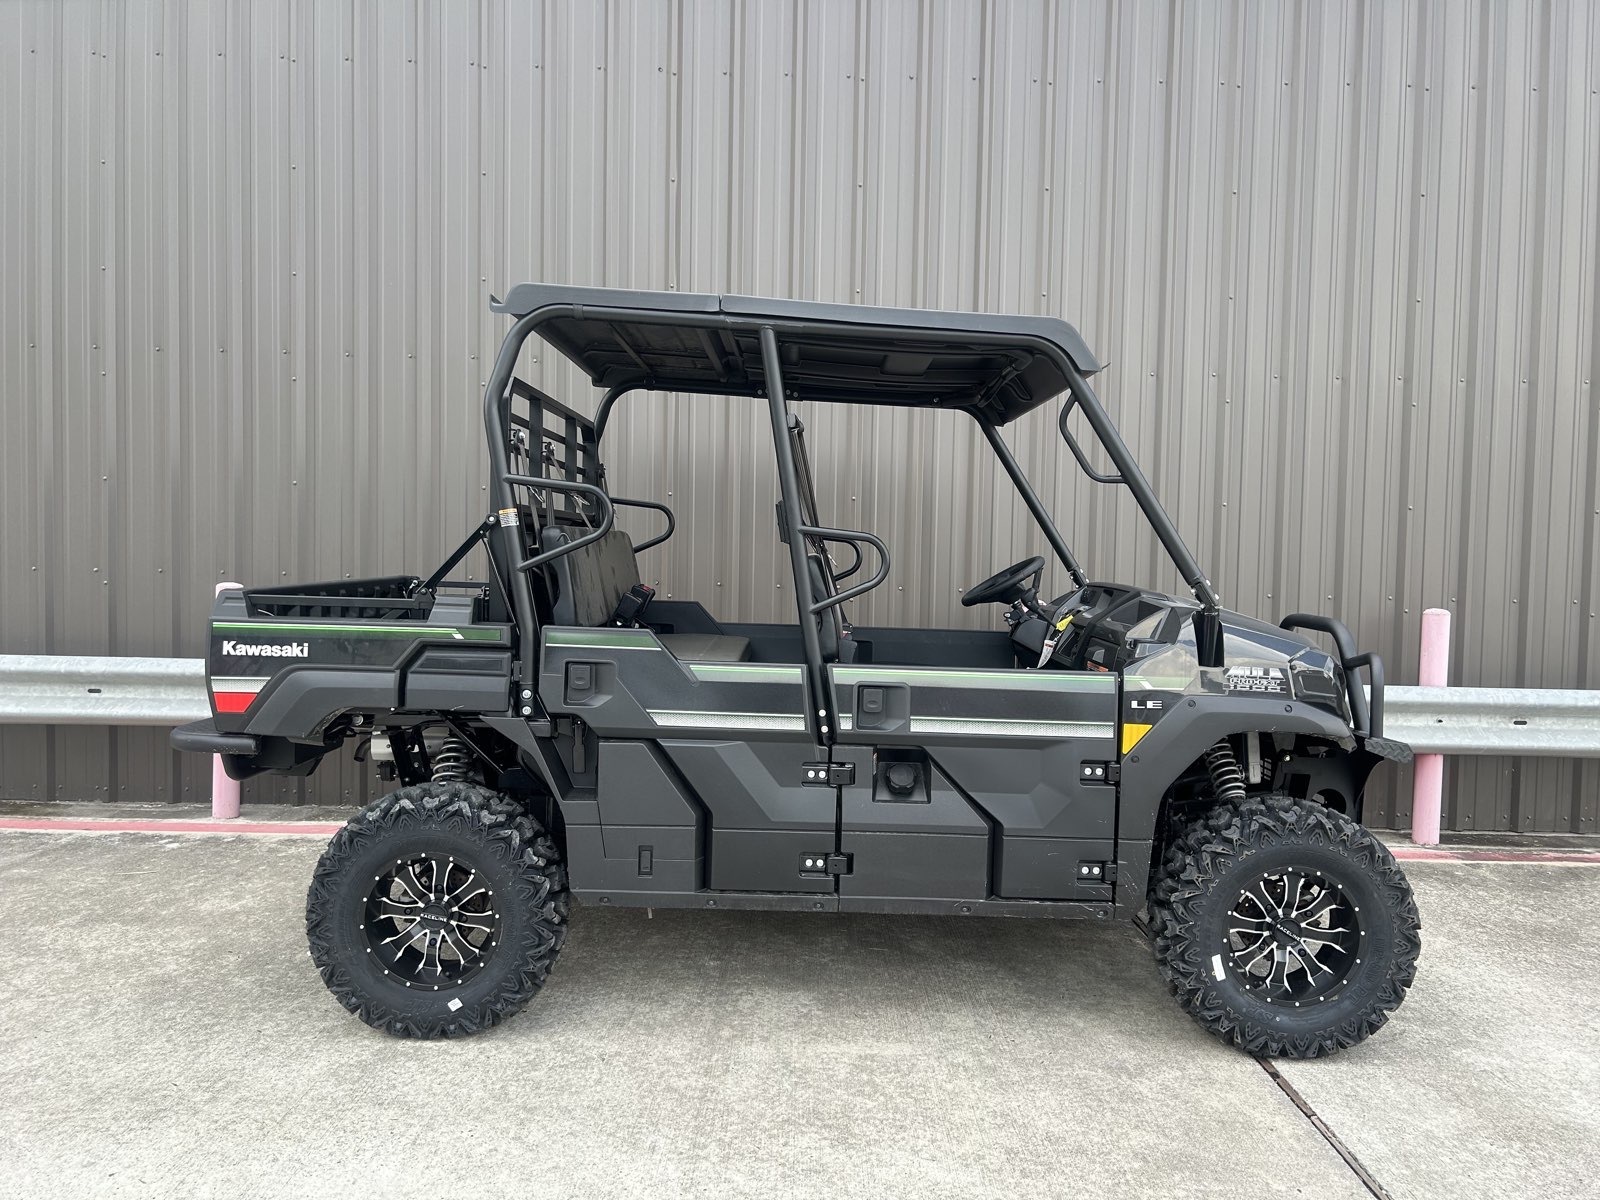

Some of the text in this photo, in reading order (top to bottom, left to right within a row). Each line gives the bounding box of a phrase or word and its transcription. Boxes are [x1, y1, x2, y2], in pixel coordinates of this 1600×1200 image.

[222, 641, 308, 658] Kawasaki
[1131, 700, 1163, 709] LE
[420, 913, 447, 923] RACELINE
[1275, 924, 1301, 942] RACELINE
